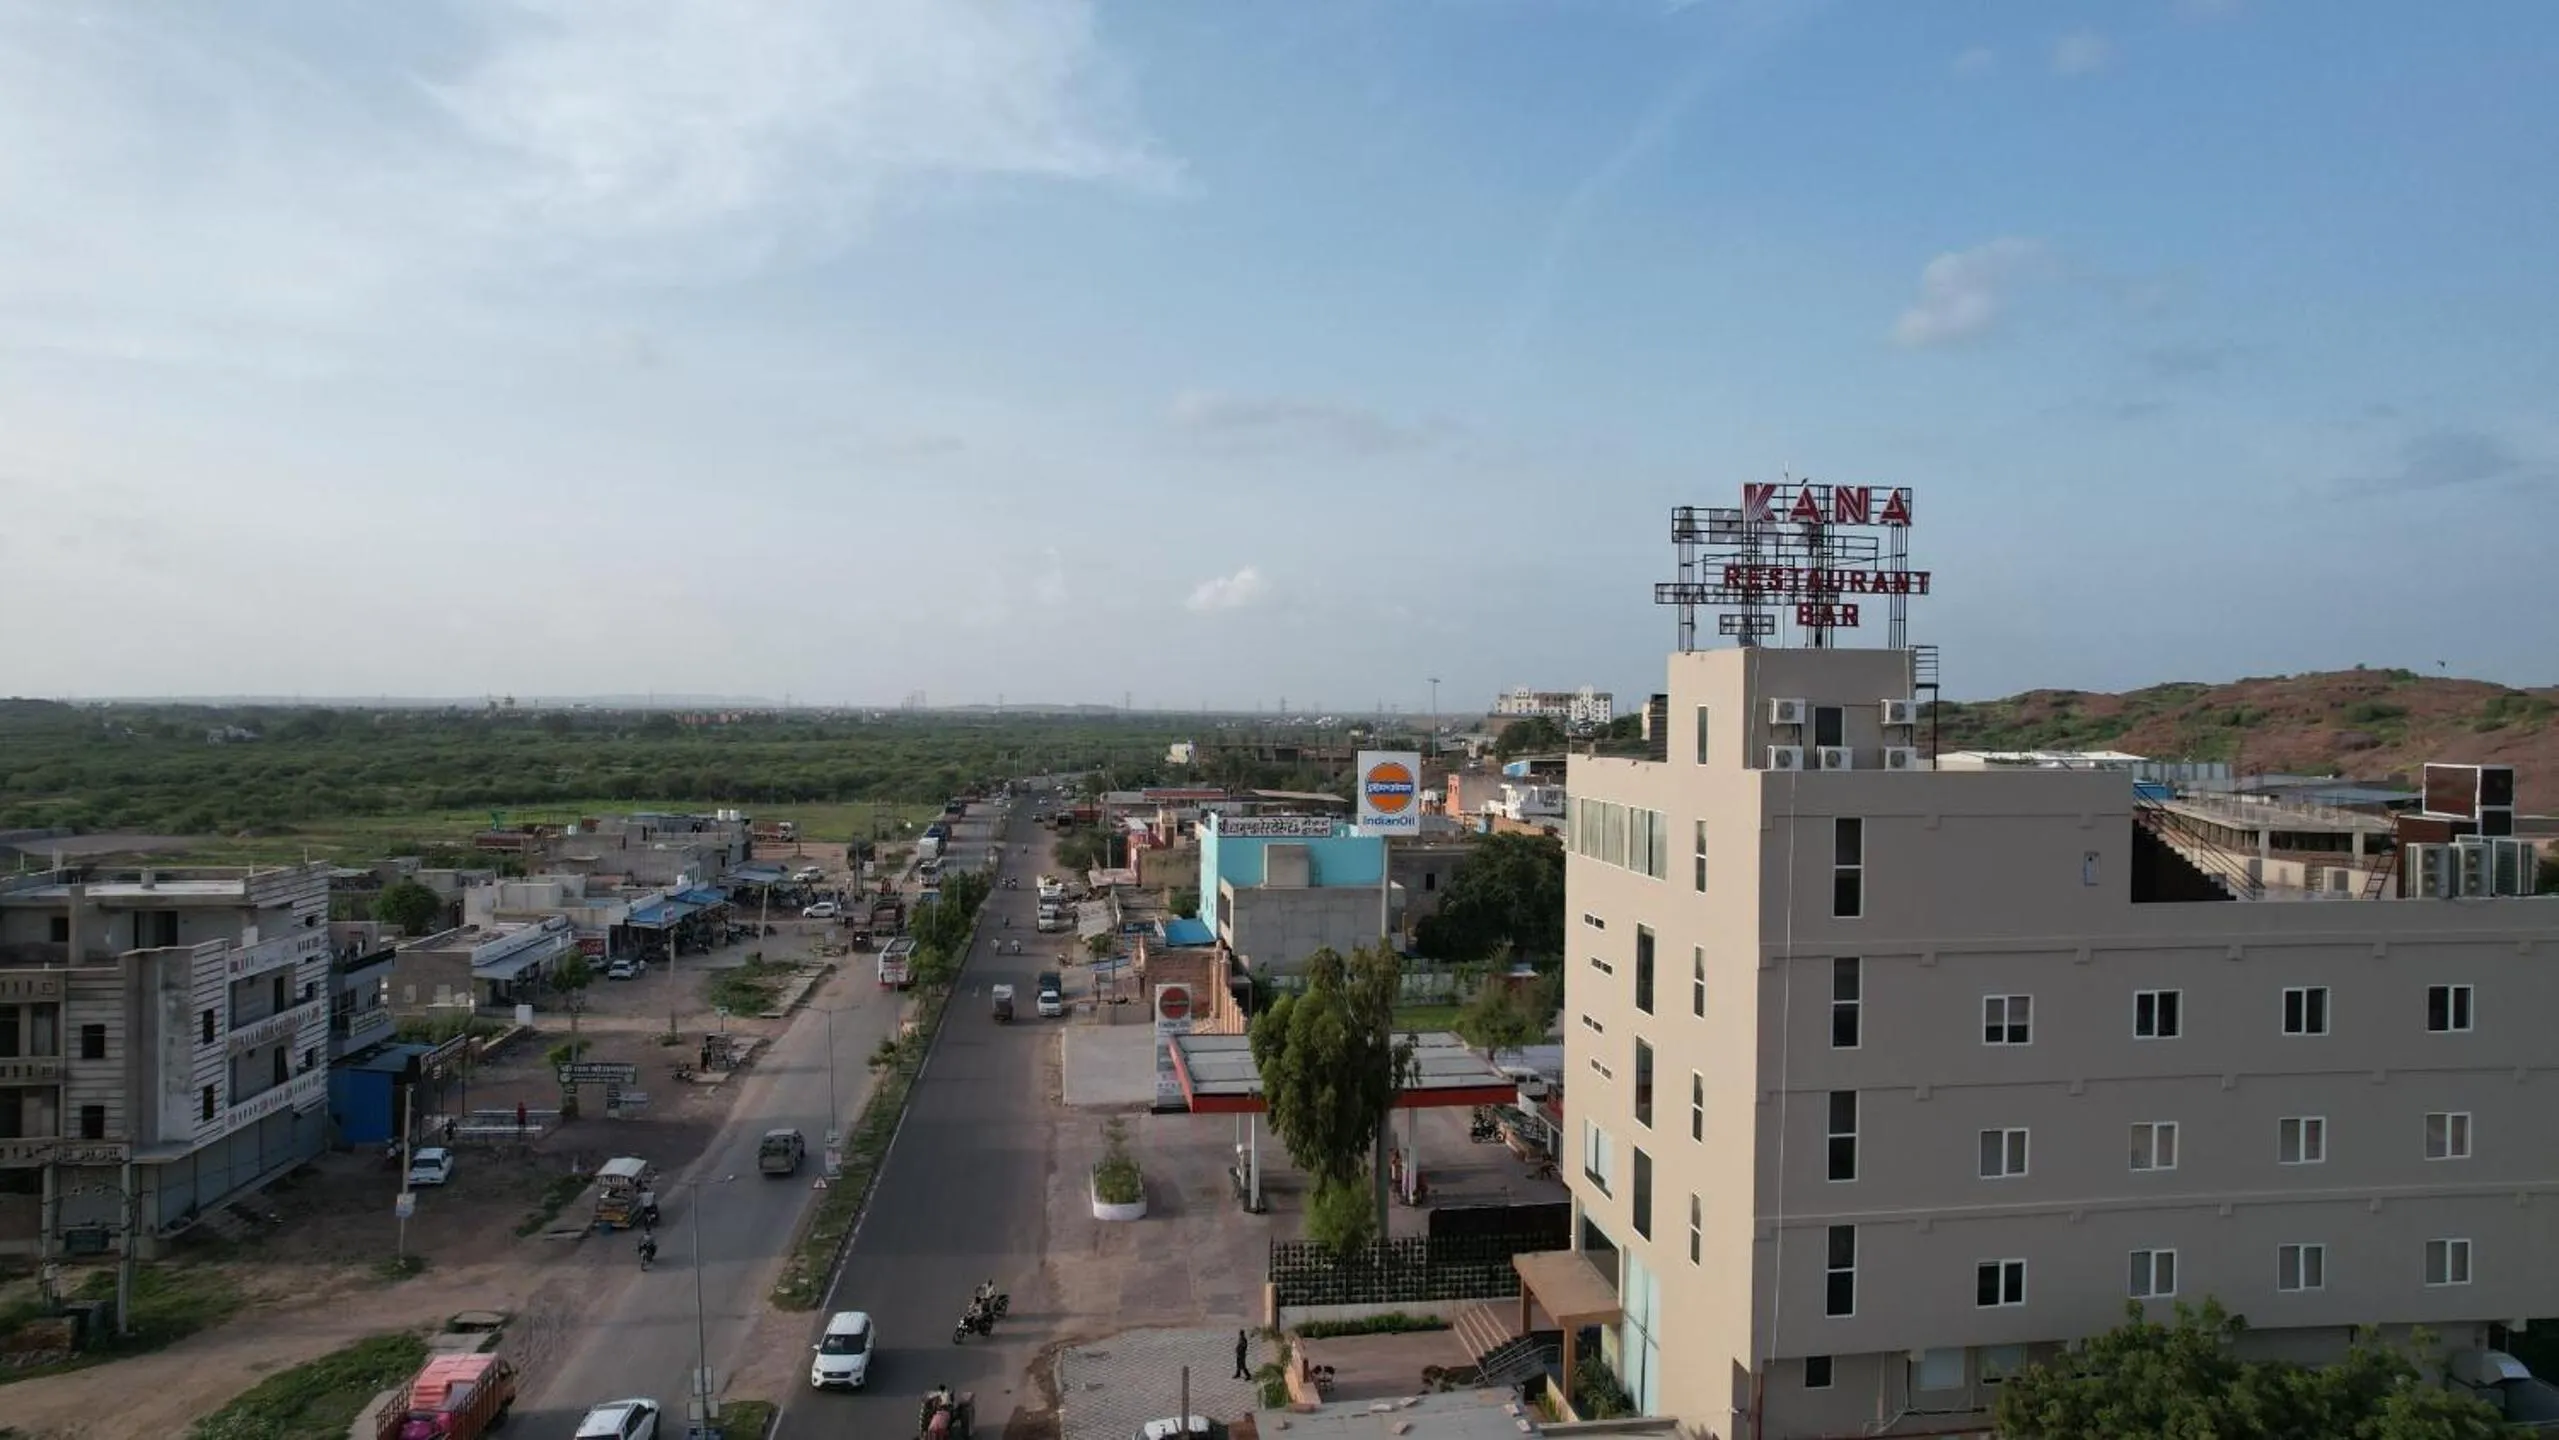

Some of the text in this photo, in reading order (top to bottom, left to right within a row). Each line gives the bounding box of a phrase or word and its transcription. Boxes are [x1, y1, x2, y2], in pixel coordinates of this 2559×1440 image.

[1743, 483, 1911, 526] KANA
[1724, 565, 1930, 594] RESTAURANT
[1797, 604, 1859, 626] BAR
[1363, 815, 1415, 826] IndianOil
